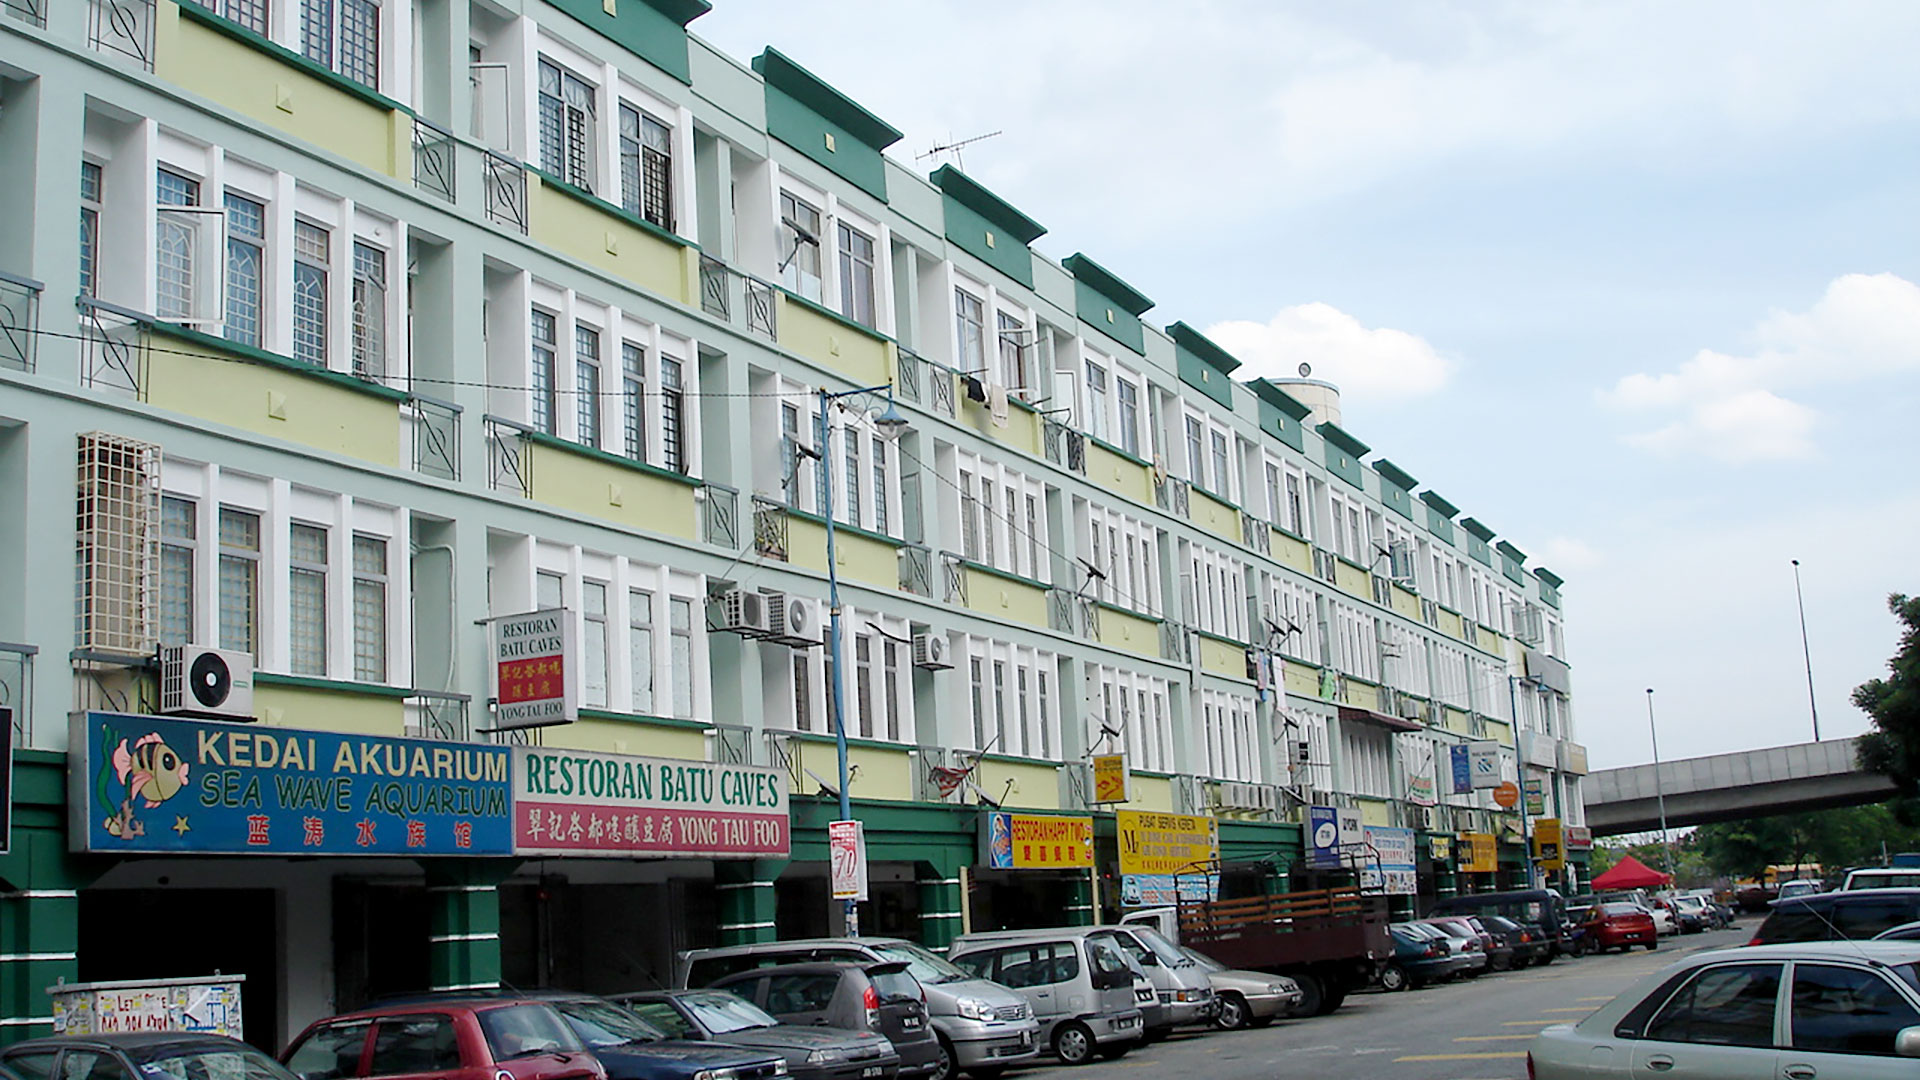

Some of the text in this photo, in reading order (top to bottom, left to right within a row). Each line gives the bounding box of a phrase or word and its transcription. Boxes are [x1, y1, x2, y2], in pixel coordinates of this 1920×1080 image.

[503, 617, 557, 638] RESTORAN
[500, 636, 562, 657] BATU CAVES
[500, 702, 563, 721] YONG TAU FOO
[198, 730, 507, 782] KEDAI AKUARIUM
[200, 769, 507, 819] SEA WAVE AQUARIUM
[526, 753, 779, 808] RESTORAN BATU CAVES
[246, 814, 473, 848] 蓝涛水族馆
[678, 817, 717, 845] YONG
[721, 818, 750, 846] TAU
[753, 819, 780, 847] FOO
